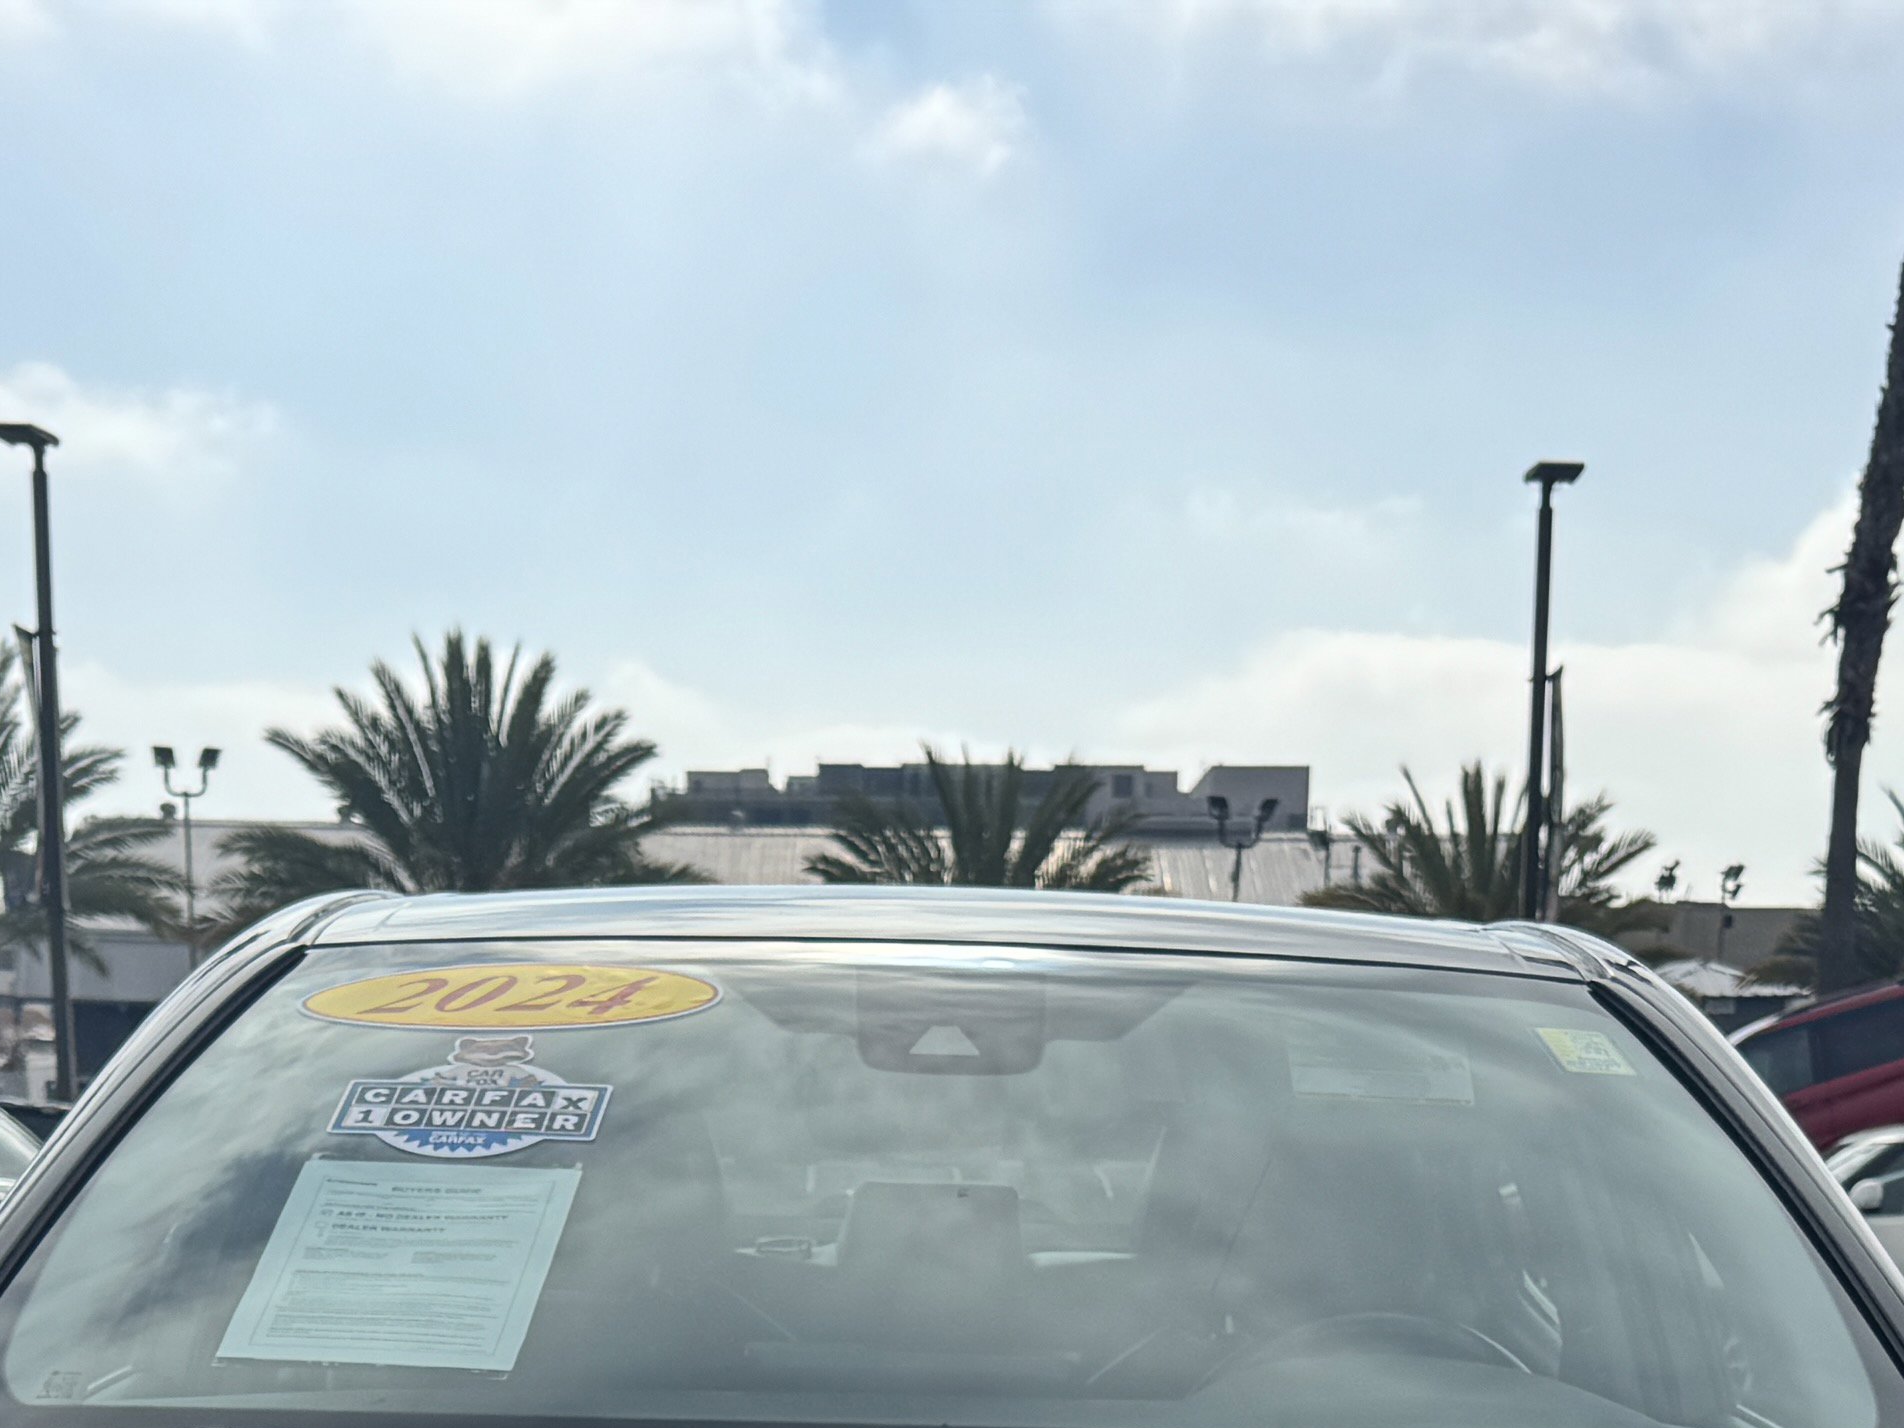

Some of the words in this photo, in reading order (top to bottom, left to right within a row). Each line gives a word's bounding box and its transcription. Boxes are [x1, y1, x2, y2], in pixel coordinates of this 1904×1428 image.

[356, 973, 660, 1016] 2024
[362, 1087, 594, 1112] CARFAX
[353, 1109, 378, 1125] 1
[392, 1110, 582, 1131] OWNER
